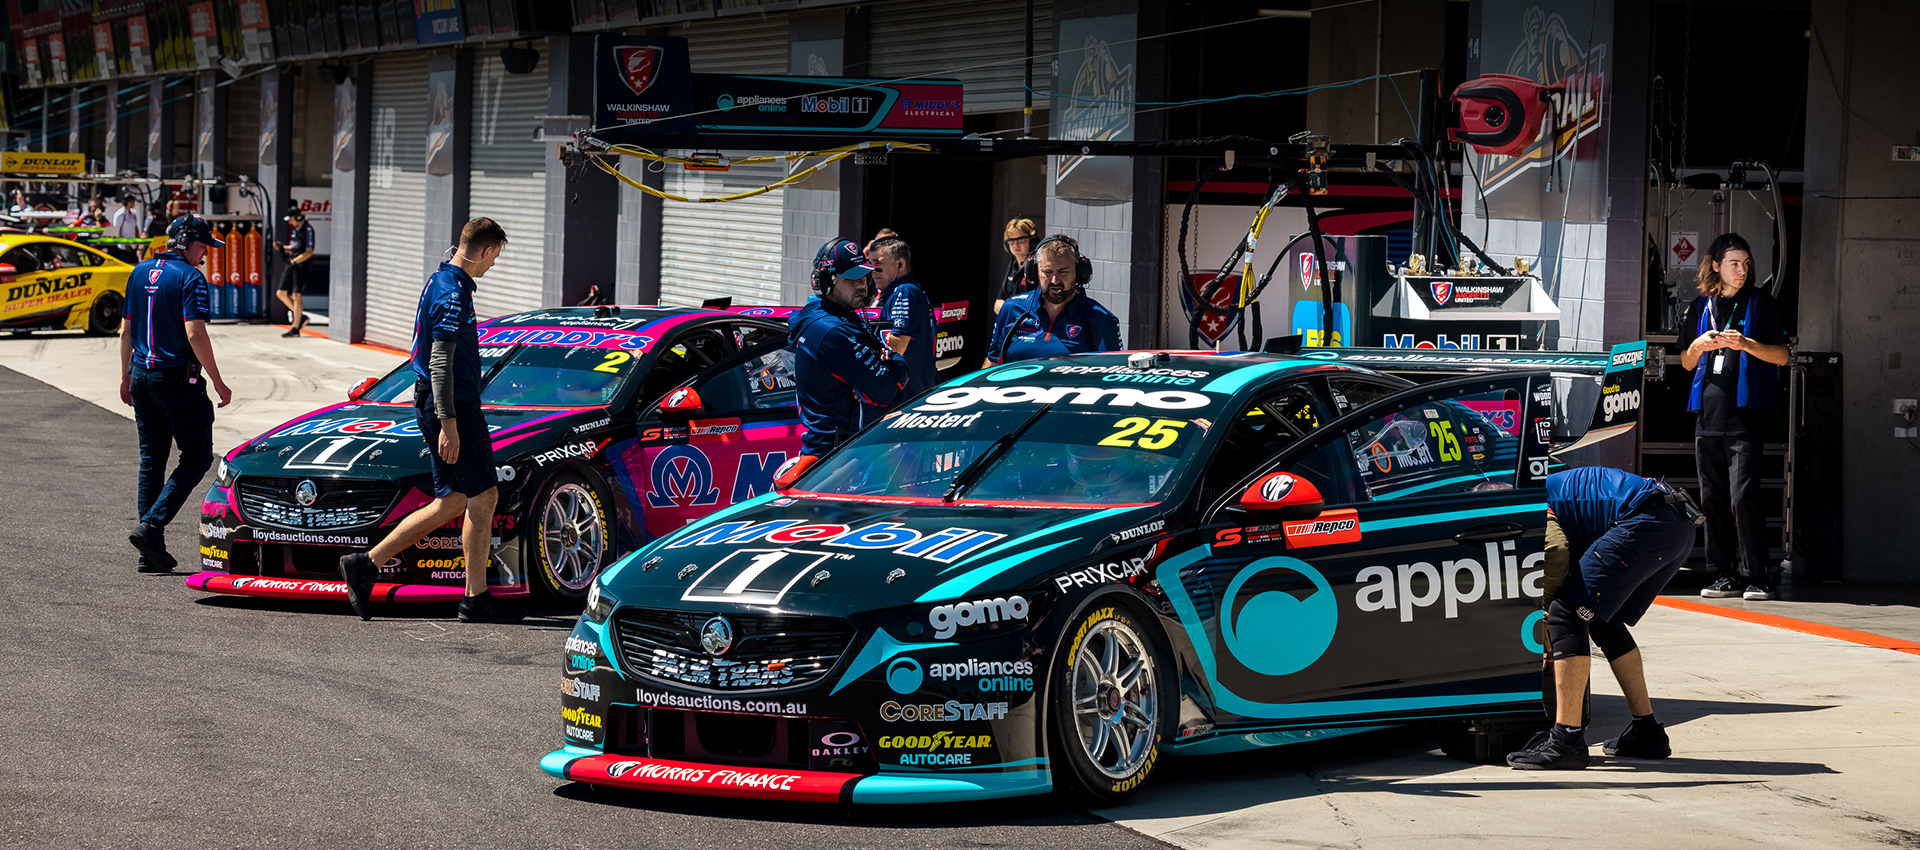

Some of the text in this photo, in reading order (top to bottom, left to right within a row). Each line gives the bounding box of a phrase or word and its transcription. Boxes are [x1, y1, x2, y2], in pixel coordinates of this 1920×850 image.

[1468, 38, 1480, 59] 14
[1051, 60, 1059, 76] 15
[607, 103, 671, 112] WALKINSHAW
[737, 95, 787, 106] appliances
[758, 104, 787, 113] online
[801, 97, 849, 113] Mobil
[914, 99, 961, 110] MIDDY'S
[617, 111, 661, 119] ANDRETTI
[22, 157, 81, 166] DUNLOP
[79, 254, 91, 267] 14
[7, 272, 94, 302] DUNLOP
[1455, 286, 1504, 294] WALKINSHAW
[4, 287, 93, 313] SUPER DEALER
[481, 329, 654, 349] MIDDY'S
[936, 335, 964, 358] gomo
[593, 351, 631, 374] 2
[1612, 351, 1643, 366] SIGNZONE
[1102, 373, 1197, 386] online
[1603, 384, 1615, 394] Good
[912, 386, 1211, 411] gomo
[1603, 390, 1641, 422] gomo
[578, 418, 611, 432] DUNLOP
[887, 411, 982, 429] Mostert
[709, 425, 739, 435] Repco
[1097, 417, 1188, 450] 25
[1429, 420, 1462, 462] 25
[533, 441, 599, 468] PRIXCAR
[590, 490, 609, 551] DUNLOP
[1313, 519, 1355, 535] Repco
[253, 529, 369, 544] lloydsauctions.com.au
[1120, 519, 1166, 541] DUNLOP
[664, 519, 1007, 563] Mobil
[834, 553, 856, 561] TM
[1055, 556, 1149, 594] PRIXCAR
[250, 579, 302, 590] MORRIS
[929, 595, 1029, 639] gomo
[1067, 607, 1115, 670] SPORT MAXX
[571, 653, 596, 672] online
[929, 659, 1034, 681] appliances
[978, 676, 1034, 692] online
[636, 688, 807, 715] lloydsauctions.com.au
[880, 701, 1009, 722] CORESTAFF
[566, 725, 595, 742] AUTOCARE
[879, 731, 992, 752] GOODYEAR
[812, 746, 869, 756] OAKLEY
[900, 753, 971, 765] AUTOCARE
[633, 763, 801, 791] MORRIS FINANCE
[1112, 747, 1159, 793] DUNLOP
